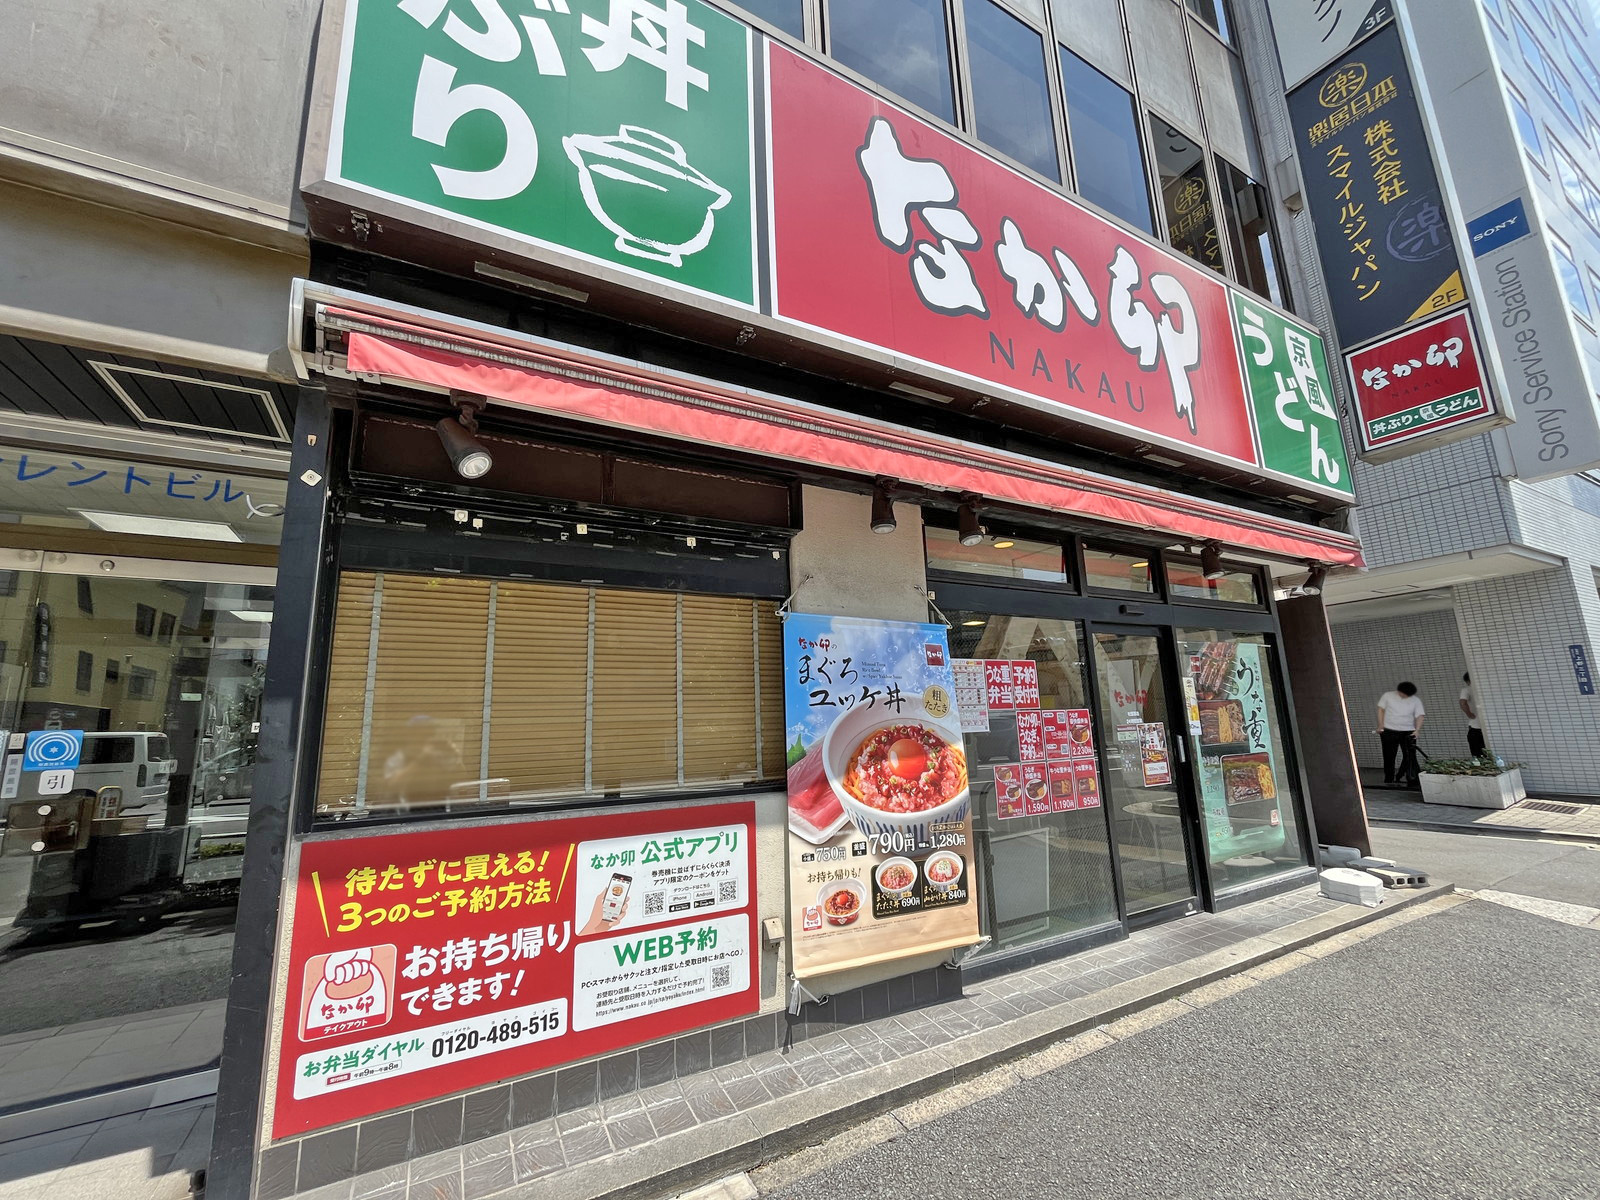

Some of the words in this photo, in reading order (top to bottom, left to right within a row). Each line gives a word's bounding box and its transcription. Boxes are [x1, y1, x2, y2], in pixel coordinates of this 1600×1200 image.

[1364, 6, 1386, 31] 3F
[1308, 75, 1398, 141] 楽居日本
[1363, 120, 1409, 205] 株式会社
[1326, 144, 1381, 301] スマイルジャパン
[1473, 216, 1518, 242] SONY
[856, 116, 1200, 436] なか卯
[1494, 256, 1532, 329] Station
[1431, 289, 1458, 309] 2F
[988, 330, 1146, 413] NAKAU
[1361, 336, 1464, 391] なか卯
[1513, 328, 1553, 405] Service
[1241, 306, 1340, 485] うどん
[1535, 407, 1570, 462] Sony
[0, 455, 244, 503] レントビル
[798, 655, 860, 685] まぐろ
[986, 665, 1011, 683] うな重
[1013, 666, 1036, 685] 予約
[808, 682, 907, 715] ユッケ丼
[924, 700, 949, 714] たたき
[989, 685, 1013, 704] 弁当
[1015, 685, 1039, 704] 受付中
[47, 774, 66, 790] 引
[590, 849, 636, 870] なか卯
[640, 831, 739, 865] 公式アプリ
[815, 846, 846, 862] 750円
[868, 831, 916, 855] 790円
[930, 833, 967, 850] 1,280円
[344, 850, 550, 897] 待たずに買える!
[336, 878, 552, 932] 3つのご予約方法
[400, 920, 571, 979] お持ち帰り
[613, 926, 718, 967] WEB予約
[320, 994, 375, 1020] なか卯
[400, 969, 525, 1016] できます!
[303, 1038, 425, 1077] お弁当ダイヤル
[432, 1011, 559, 1058] 0120-489-515
[323, 1018, 368, 1035] テイクアウト
